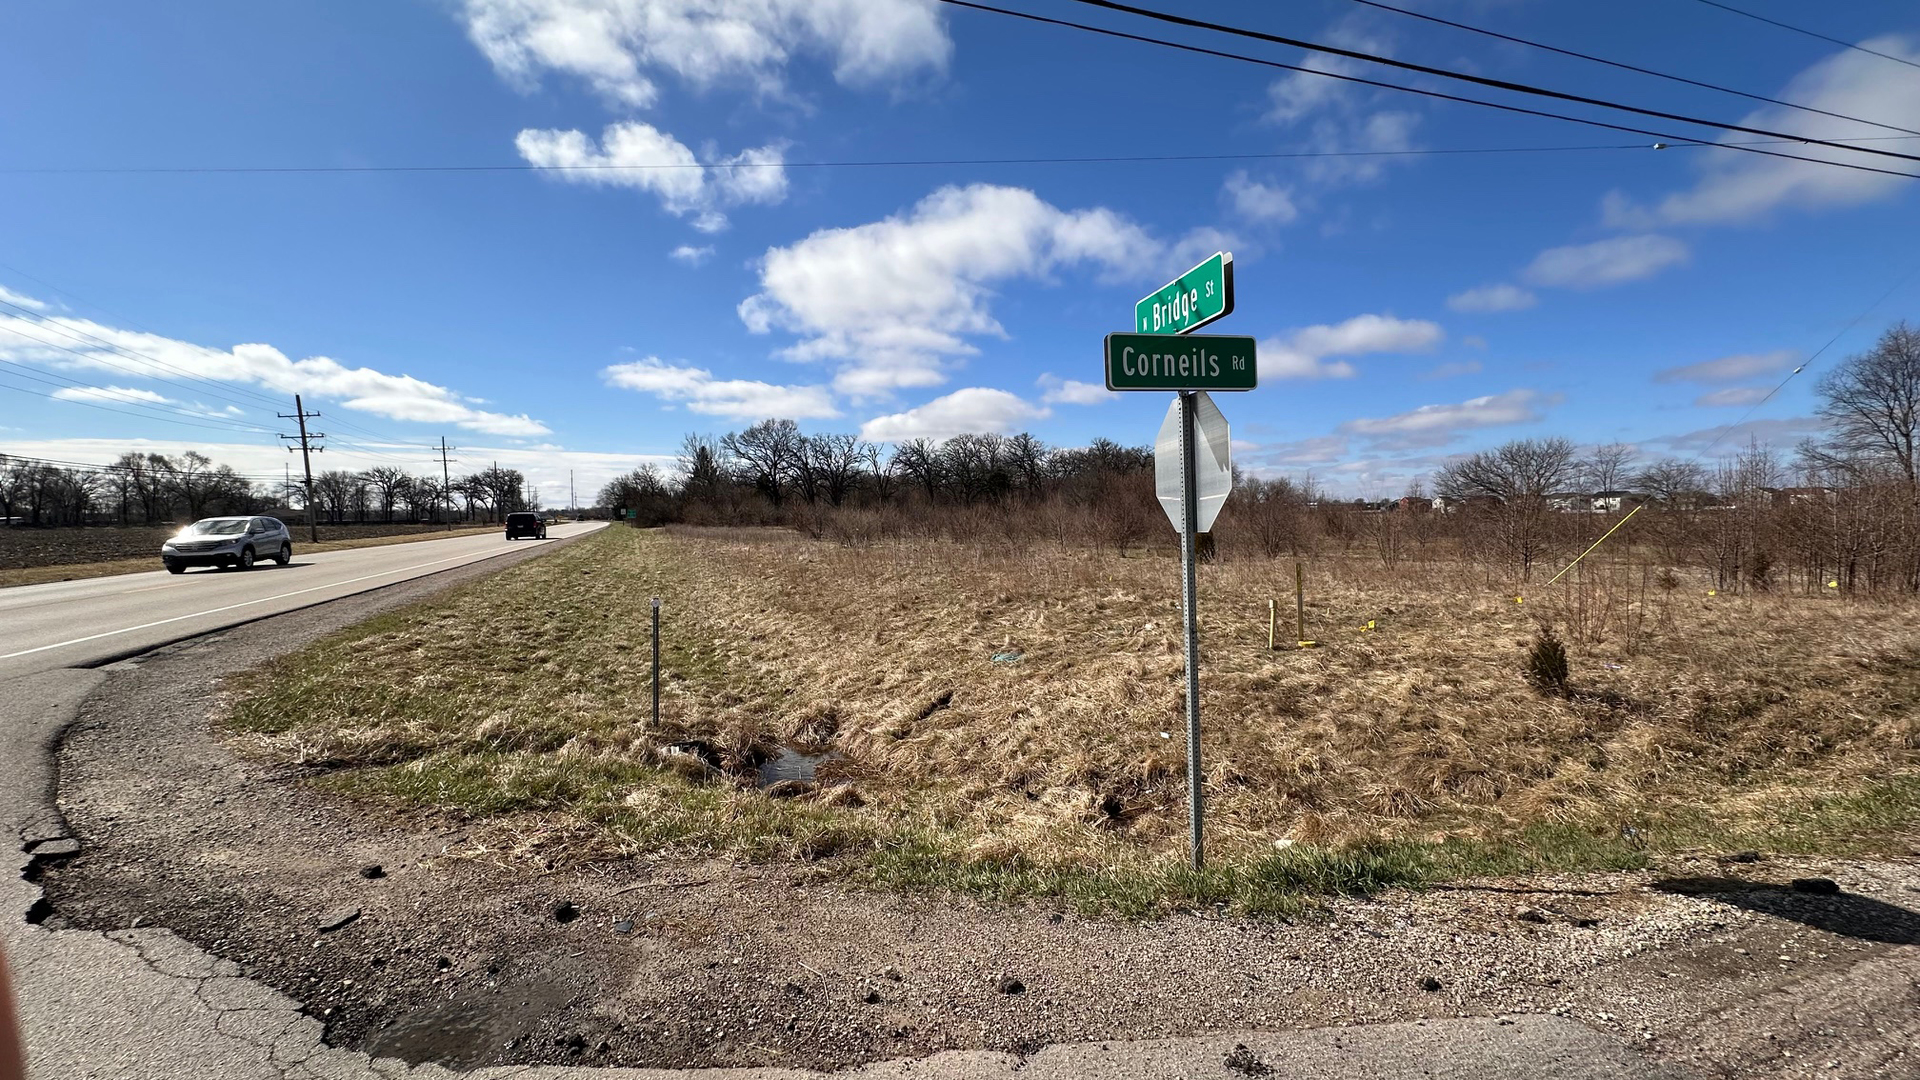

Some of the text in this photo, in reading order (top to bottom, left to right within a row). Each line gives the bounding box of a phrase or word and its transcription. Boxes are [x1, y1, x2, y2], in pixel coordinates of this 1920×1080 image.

[1152, 287, 1198, 332] Bridge
[1205, 279, 1214, 298] St
[1122, 346, 1245, 377] Corneils Rd
